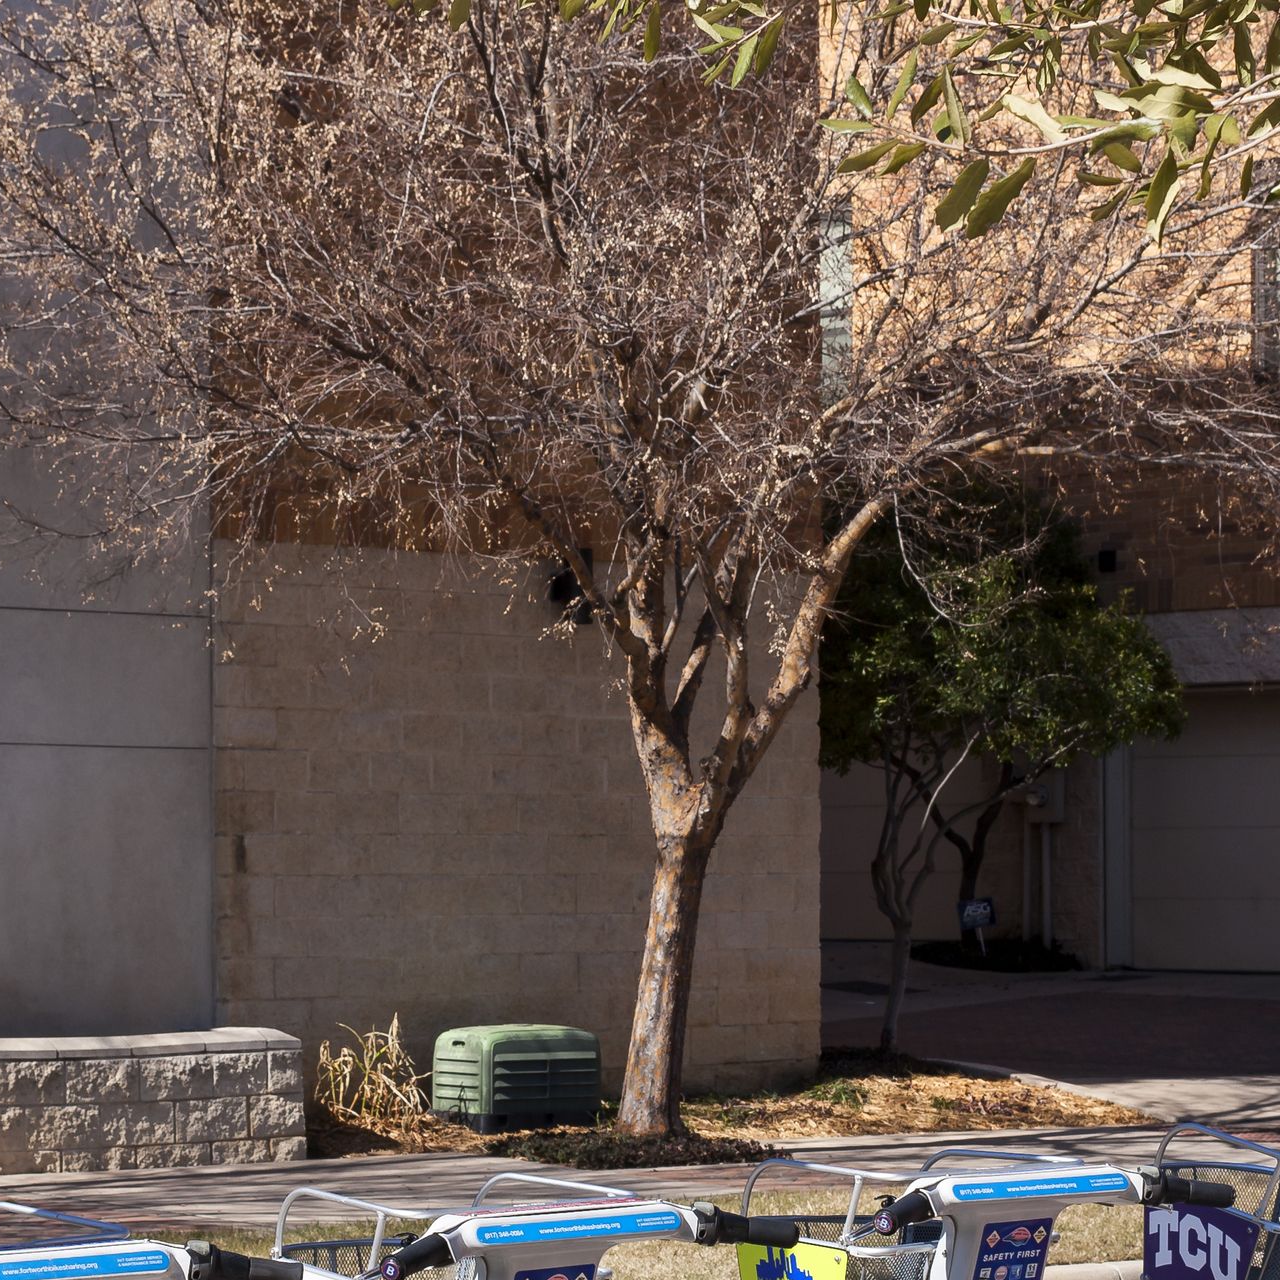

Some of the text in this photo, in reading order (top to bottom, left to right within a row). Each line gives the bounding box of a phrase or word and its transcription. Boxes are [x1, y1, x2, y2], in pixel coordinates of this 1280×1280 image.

[982, 1249, 1041, 1262] SAFETY FIRST
[386, 1265, 396, 1276] B
